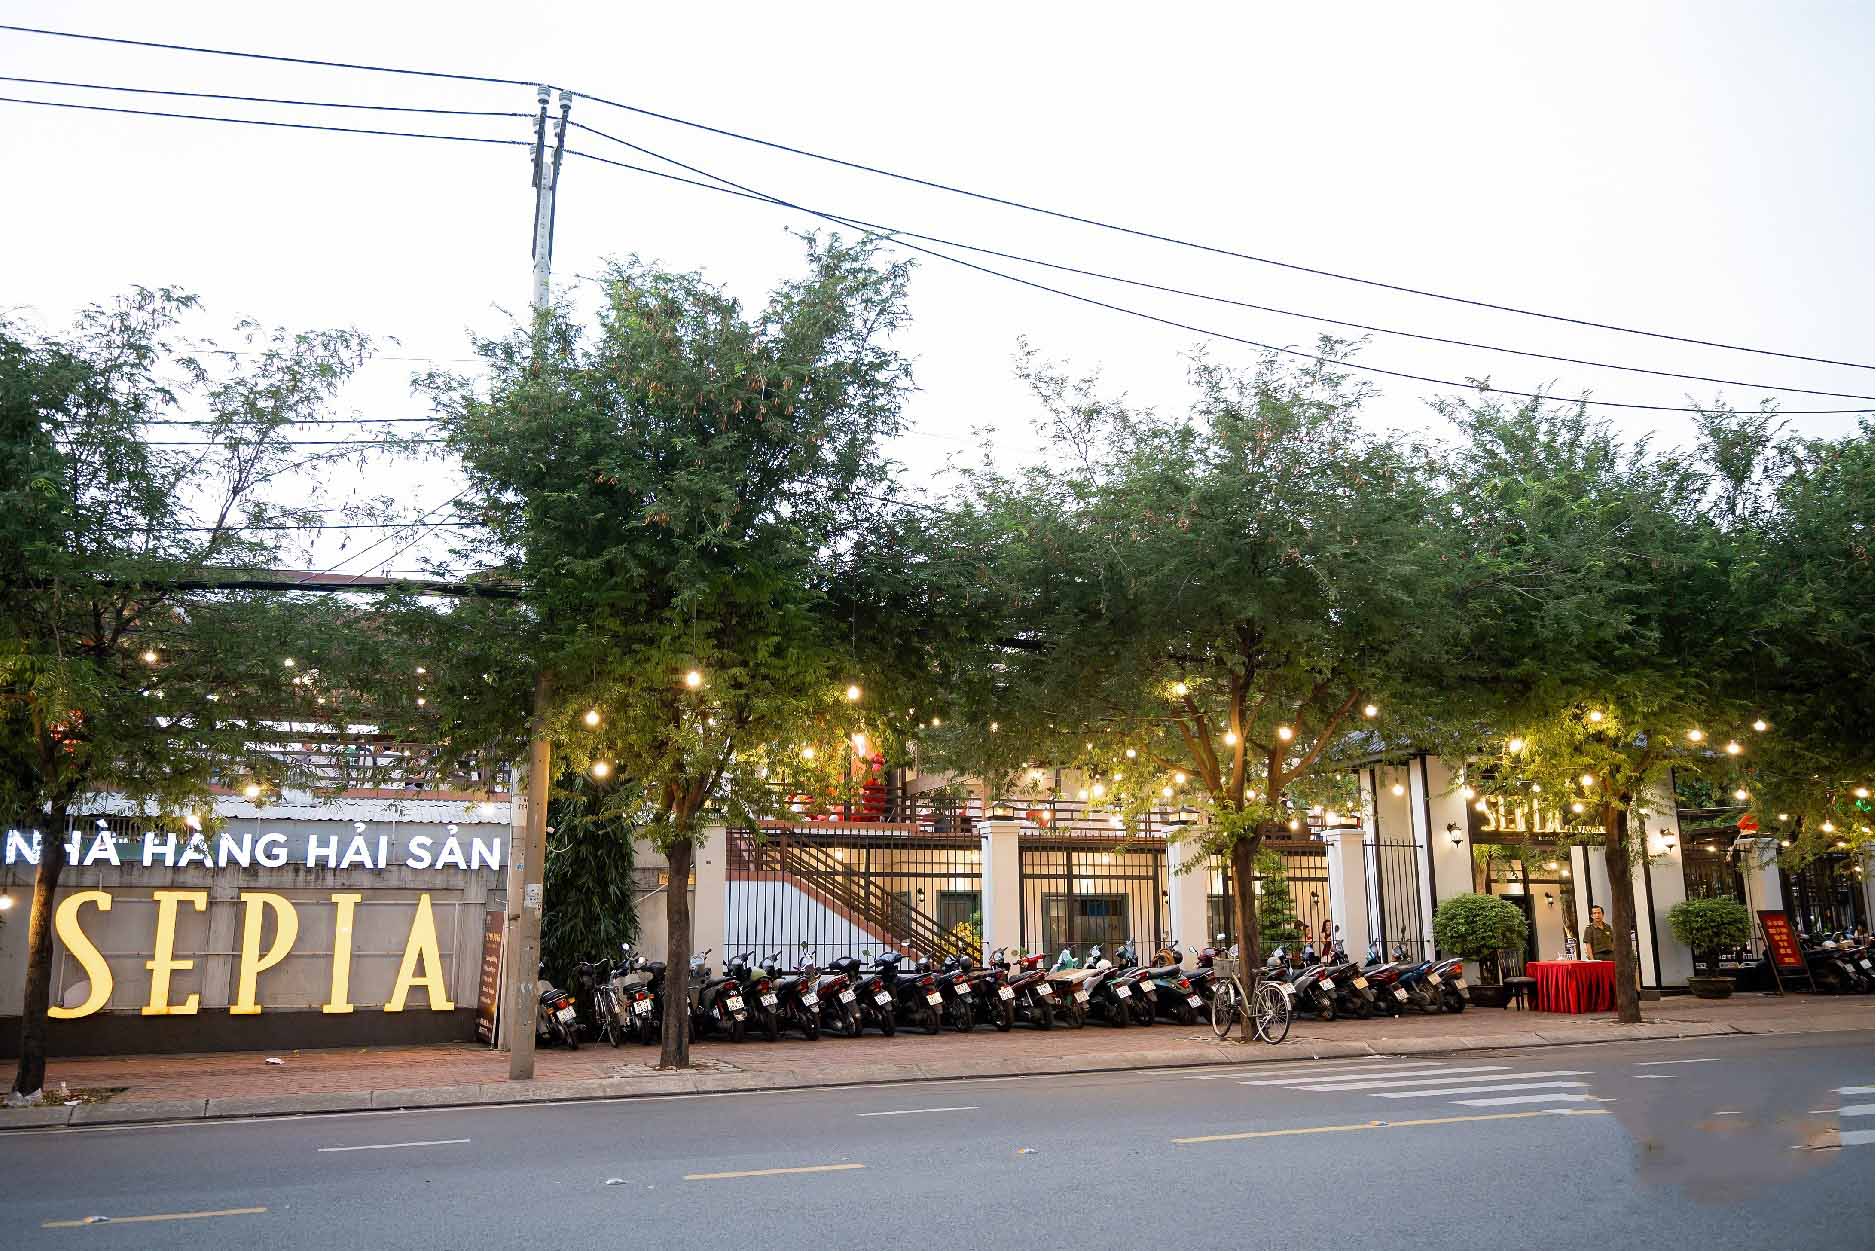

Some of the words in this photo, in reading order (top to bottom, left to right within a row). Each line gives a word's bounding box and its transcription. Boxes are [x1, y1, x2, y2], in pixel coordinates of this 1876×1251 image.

[142, 820, 288, 868] HÀNG
[306, 822, 388, 869] HẢI
[406, 824, 501, 870] SẢN
[47, 890, 456, 1019] SEPIA
